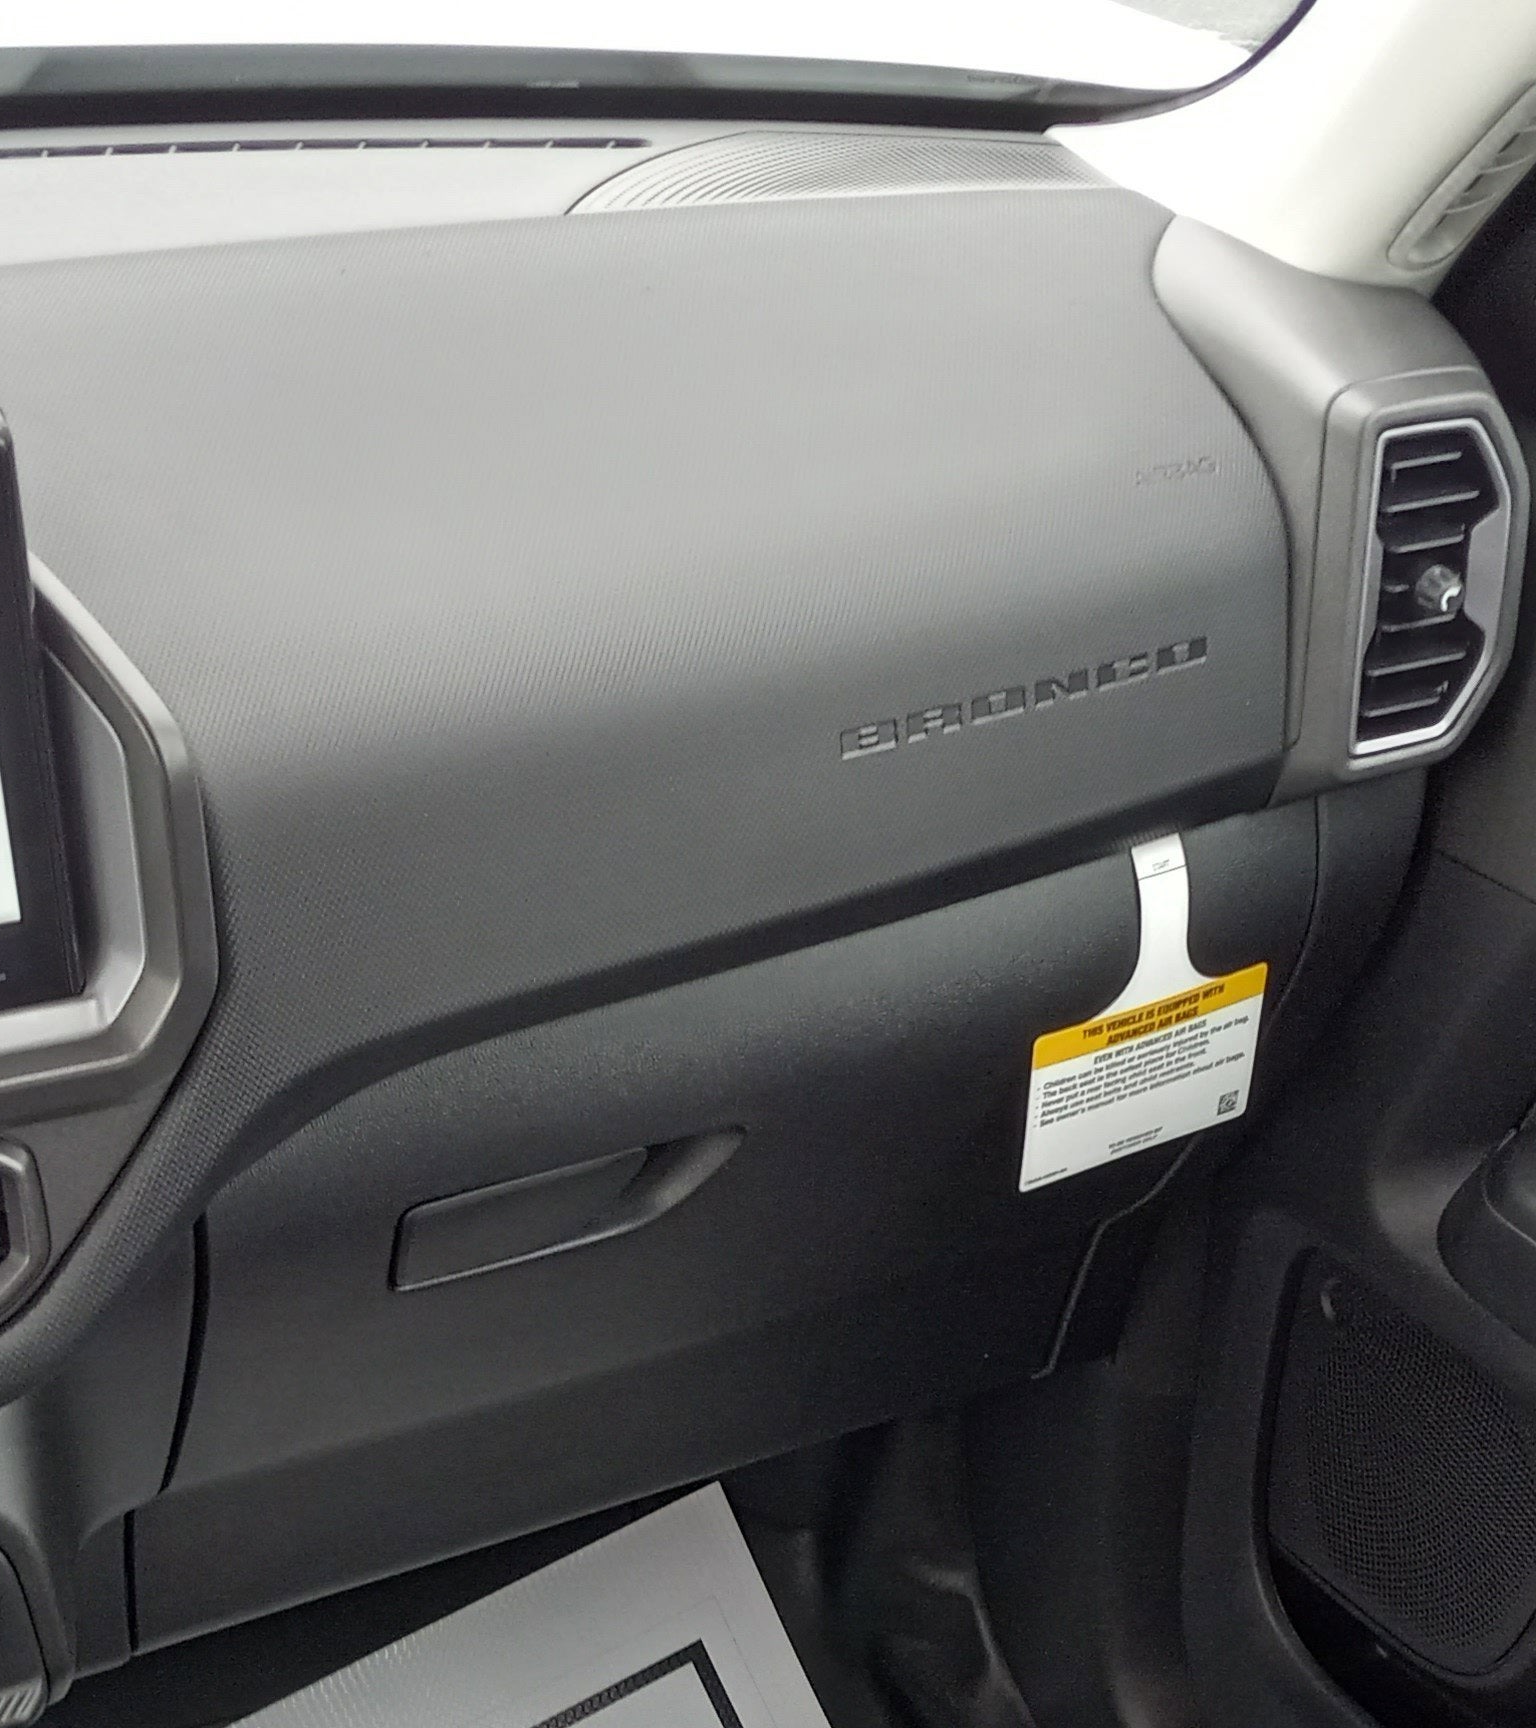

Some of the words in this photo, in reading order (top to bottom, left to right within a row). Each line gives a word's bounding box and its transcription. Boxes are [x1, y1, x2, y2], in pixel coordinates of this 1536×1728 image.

[840, 636, 1207, 760] BRONCO
[1145, 1009, 1154, 1019] IS
[1202, 984, 1224, 999] WITH
[1157, 1016, 1172, 1029] AIR
